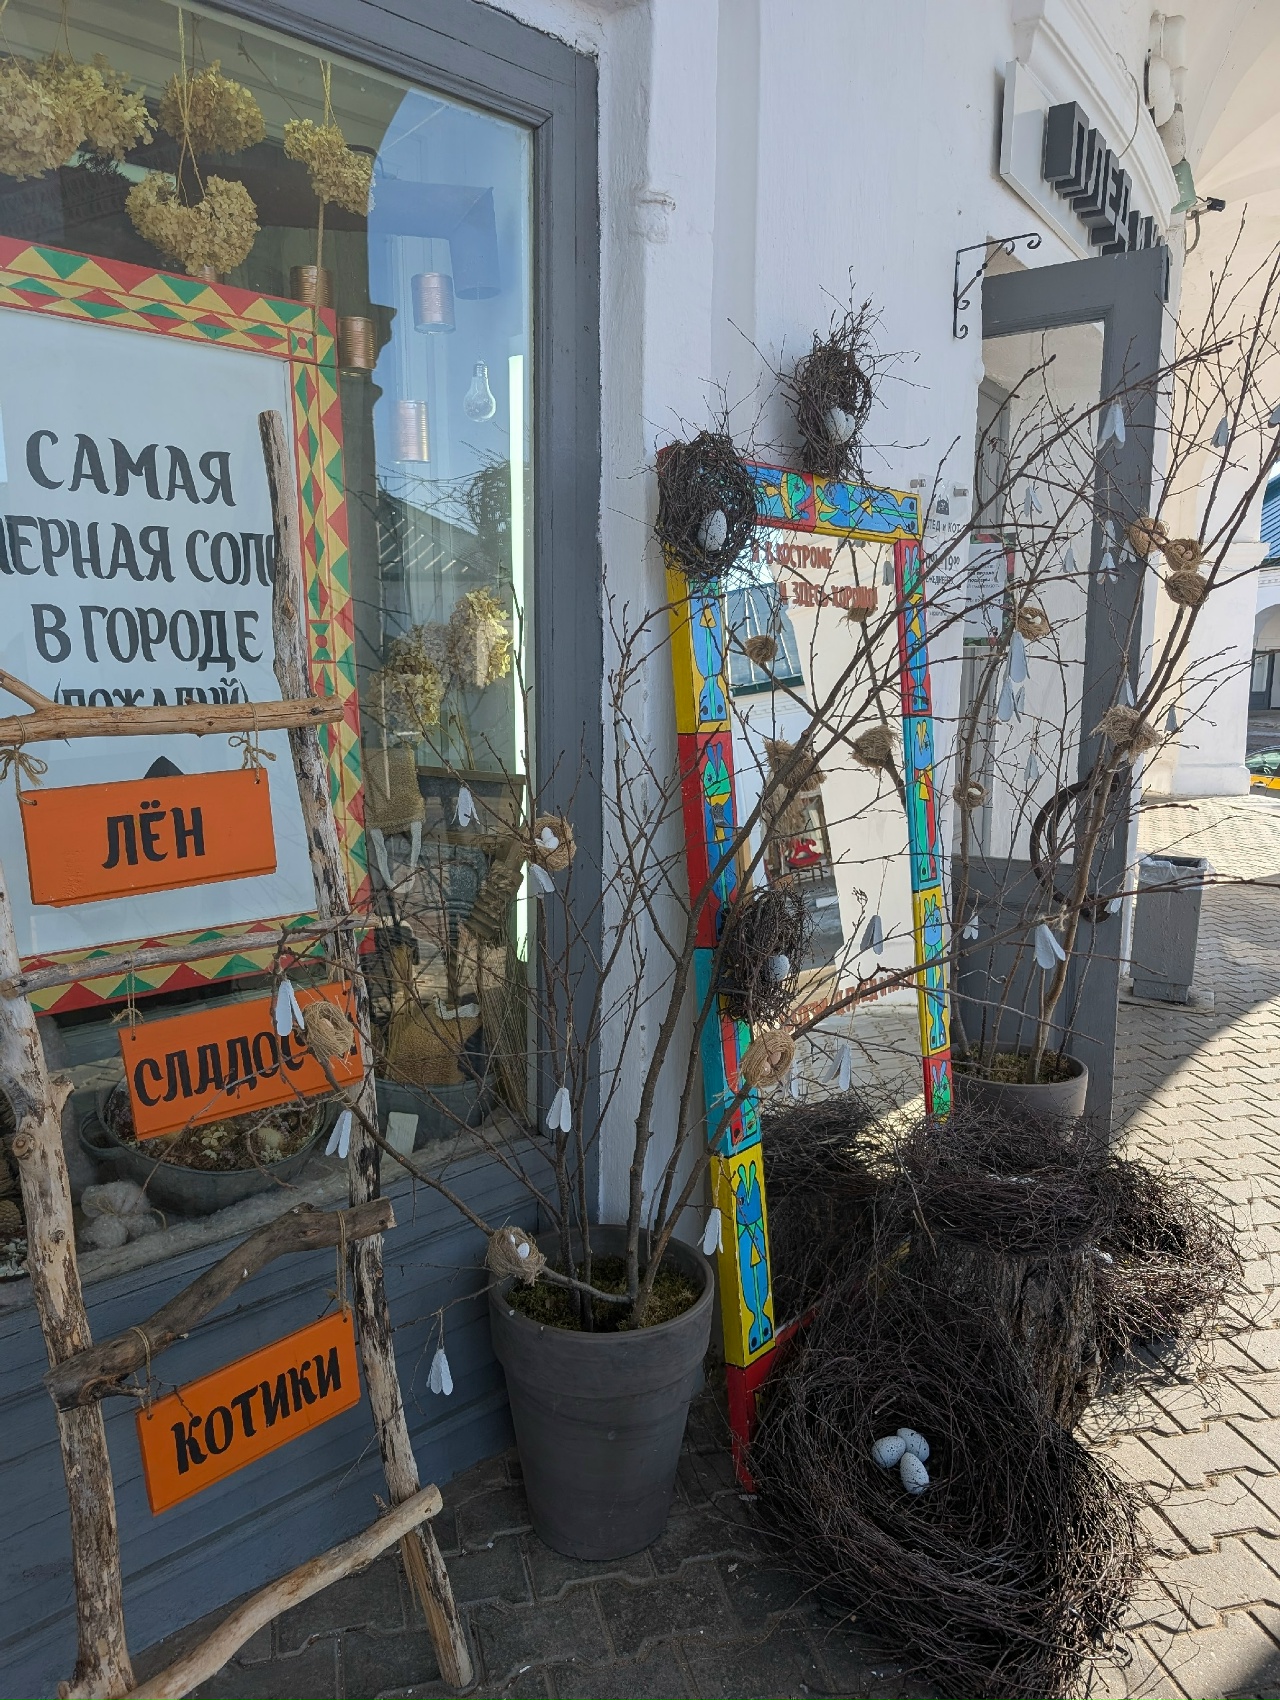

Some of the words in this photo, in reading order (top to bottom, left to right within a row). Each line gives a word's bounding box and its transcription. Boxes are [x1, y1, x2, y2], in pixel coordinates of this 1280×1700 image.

[26, 430, 236, 506] САМАЯ
[776, 542, 833, 569] КОСТРОМЕ
[31, 604, 72, 663] В
[79, 605, 263, 673] ГОРОДЕ
[101, 799, 206, 869] ЛЁН
[133, 1012, 357, 1106] СЛАДОС
[170, 1346, 342, 1475] КОТИКИ
